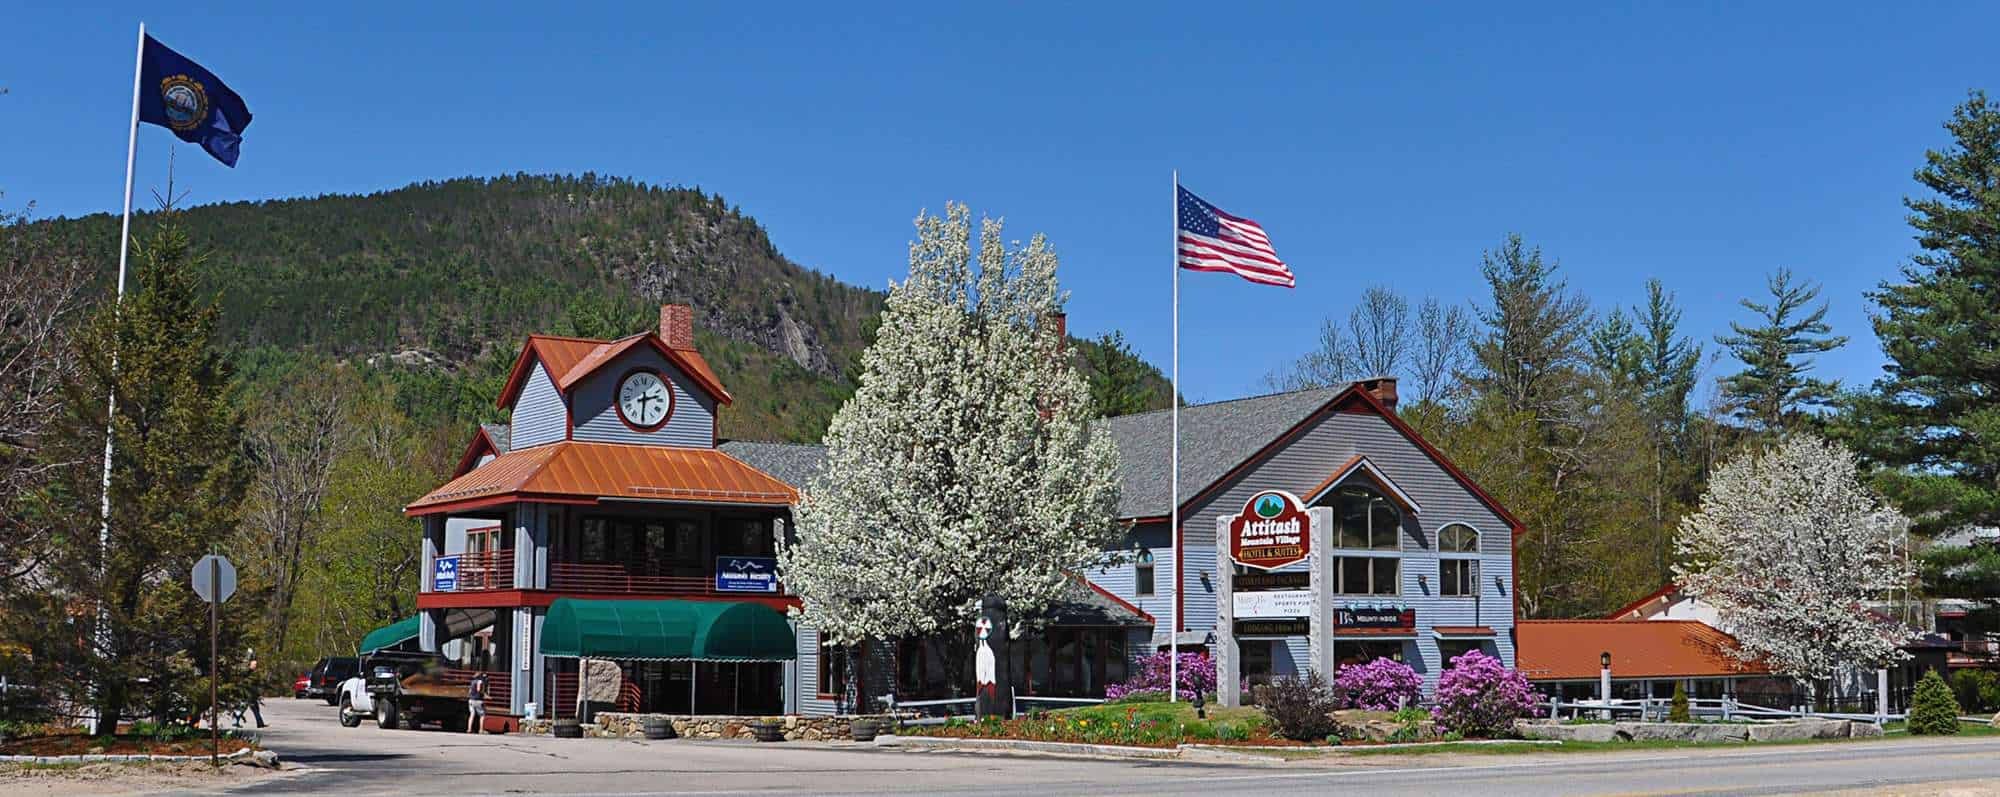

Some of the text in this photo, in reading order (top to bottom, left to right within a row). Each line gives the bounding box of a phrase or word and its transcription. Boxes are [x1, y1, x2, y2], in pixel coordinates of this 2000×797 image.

[1240, 517, 1300, 536] Attitash
[1240, 535, 1301, 547] Mountain Village
[1243, 547, 1298, 558] HOTEL & SUITES
